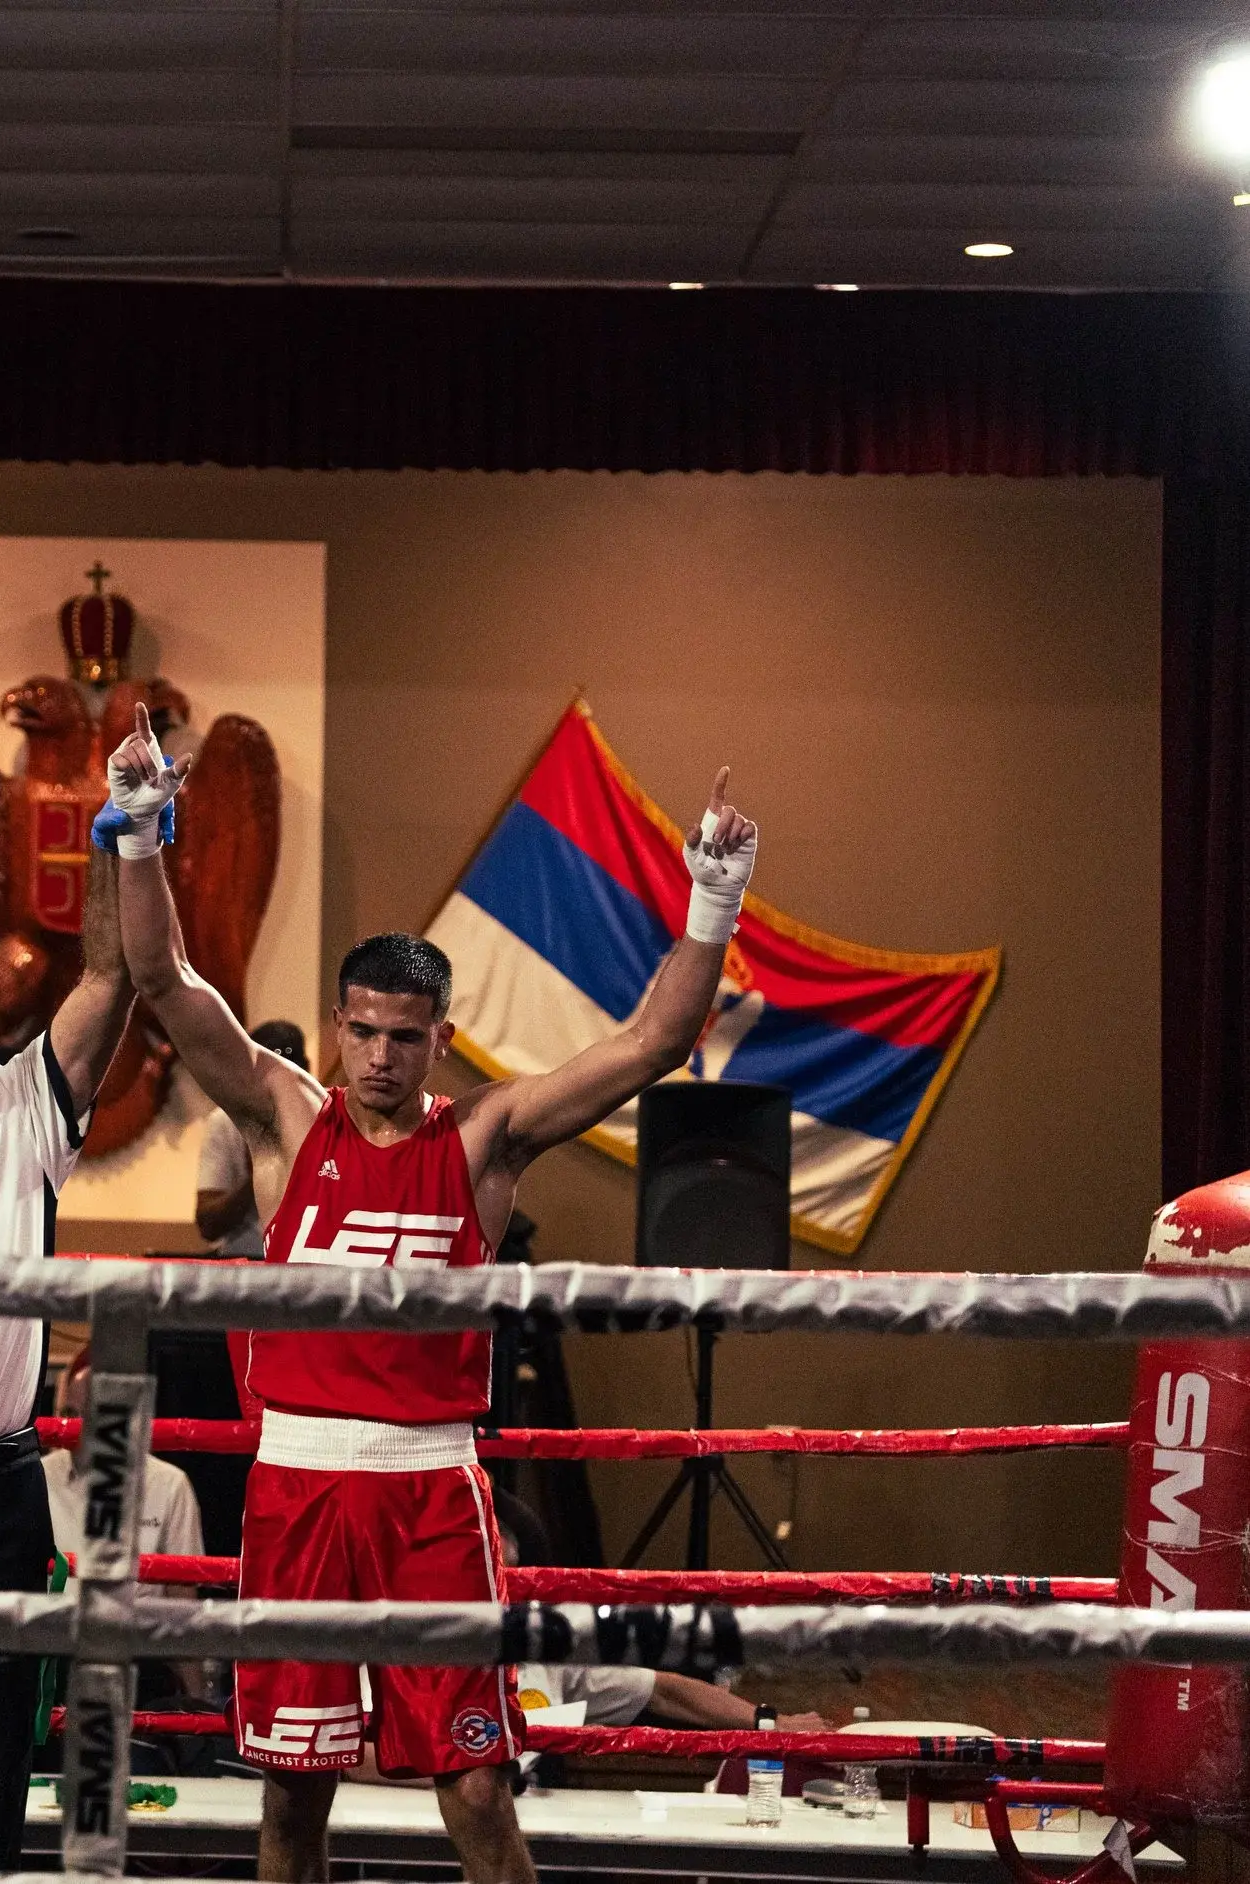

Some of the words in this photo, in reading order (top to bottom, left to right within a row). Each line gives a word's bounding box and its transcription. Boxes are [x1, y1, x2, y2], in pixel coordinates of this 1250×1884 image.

[287, 1205, 464, 1269] LEE
[84, 1404, 130, 1541] SMAI
[1145, 1371, 1210, 1669] SMA
[76, 1701, 114, 1836] SMAI
[245, 1702, 362, 1754] LEE
[272, 1755, 300, 1767] EAST
[303, 1754, 358, 1767] EXOTICS
